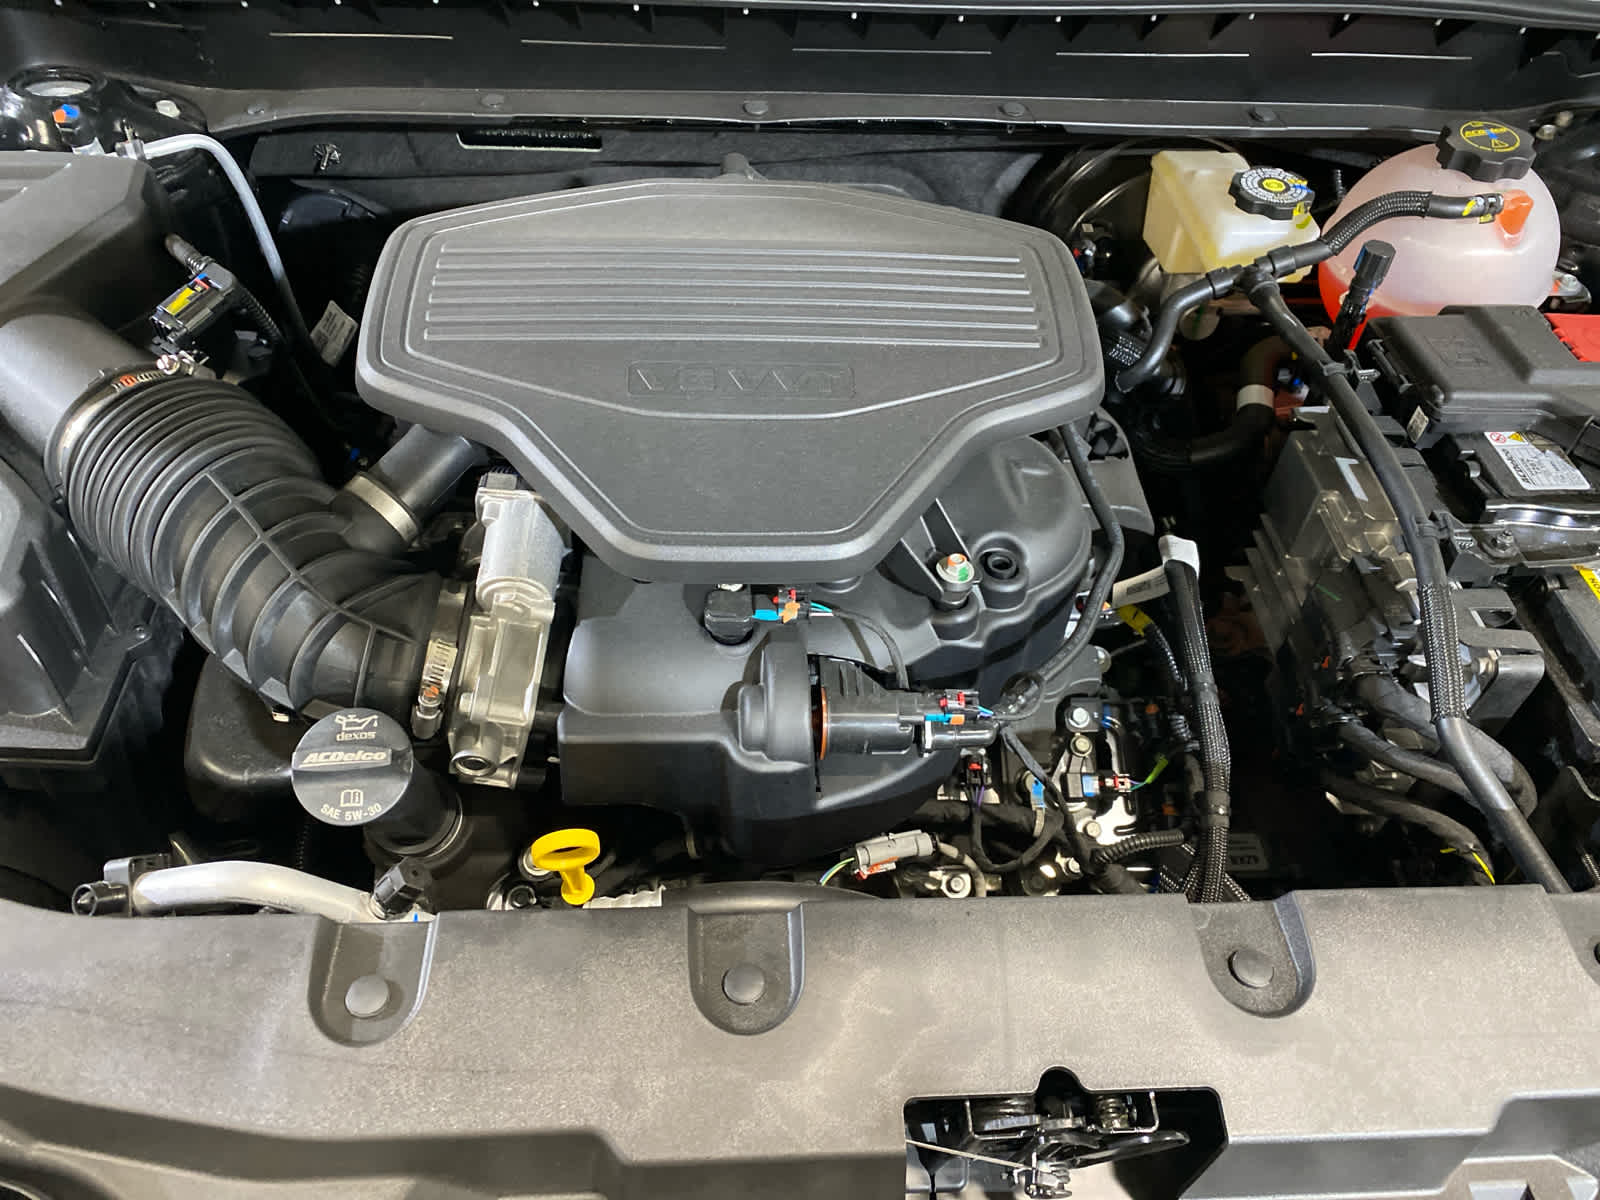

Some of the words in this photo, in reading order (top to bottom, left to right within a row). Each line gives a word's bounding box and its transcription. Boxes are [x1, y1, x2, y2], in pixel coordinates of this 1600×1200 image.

[336, 731, 376, 741] dexos
[302, 750, 386, 763] ACDelco
[320, 803, 341, 820] SAE
[344, 803, 382, 821] 5W-30
